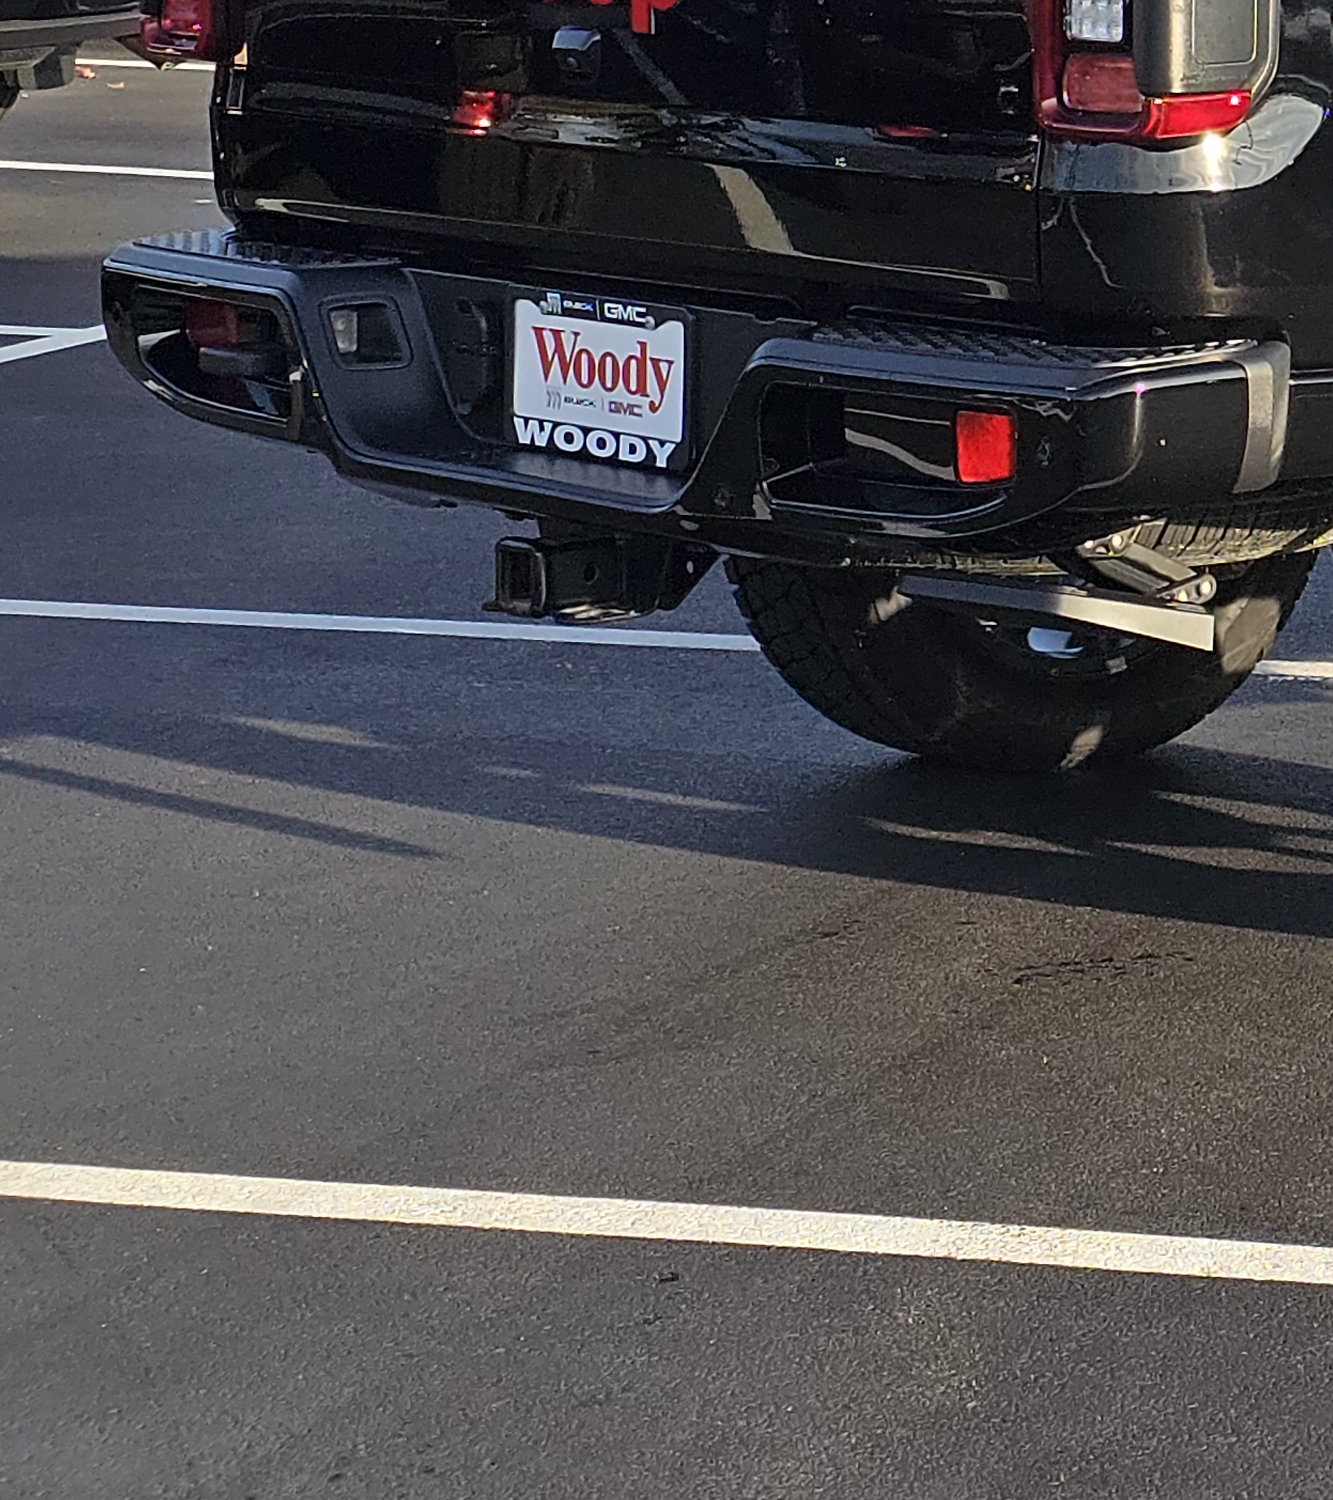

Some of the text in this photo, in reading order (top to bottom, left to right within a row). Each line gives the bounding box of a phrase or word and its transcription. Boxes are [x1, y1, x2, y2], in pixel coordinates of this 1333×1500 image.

[603, 302, 647, 323] GMC
[531, 326, 675, 413] Woody
[608, 400, 643, 418] GMC
[513, 416, 677, 468] WOODY
